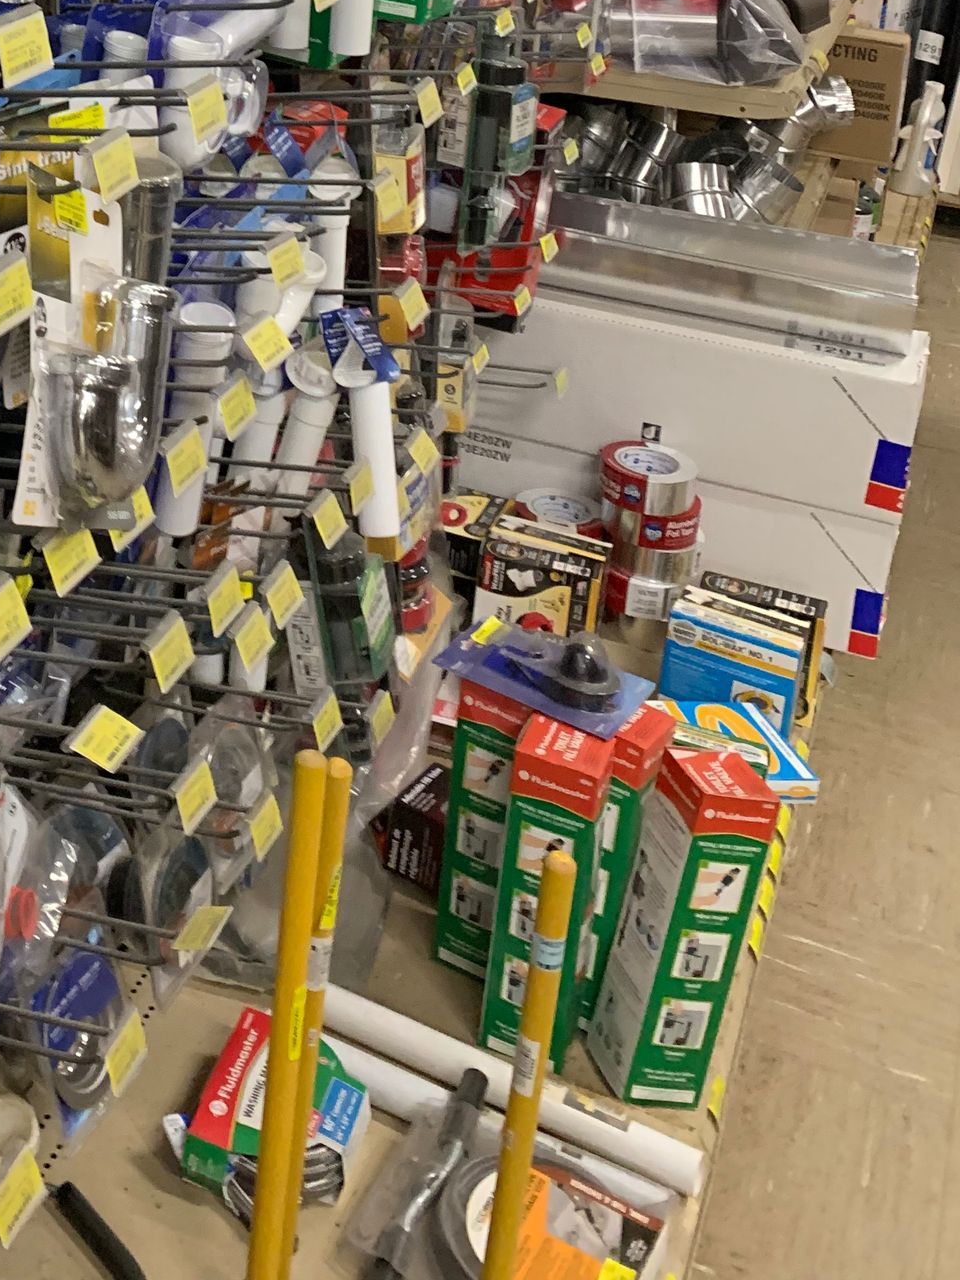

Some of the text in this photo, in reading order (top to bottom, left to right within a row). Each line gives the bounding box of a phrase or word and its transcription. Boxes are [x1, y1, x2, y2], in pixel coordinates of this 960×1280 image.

[828, 42, 878, 63] CTING
[530, 774, 591, 801] Fluidmaster
[716, 810, 772, 824] Fluidmaster
[217, 1027, 260, 1100] Fluidmaster
[243, 1077, 266, 1119] WASHING
